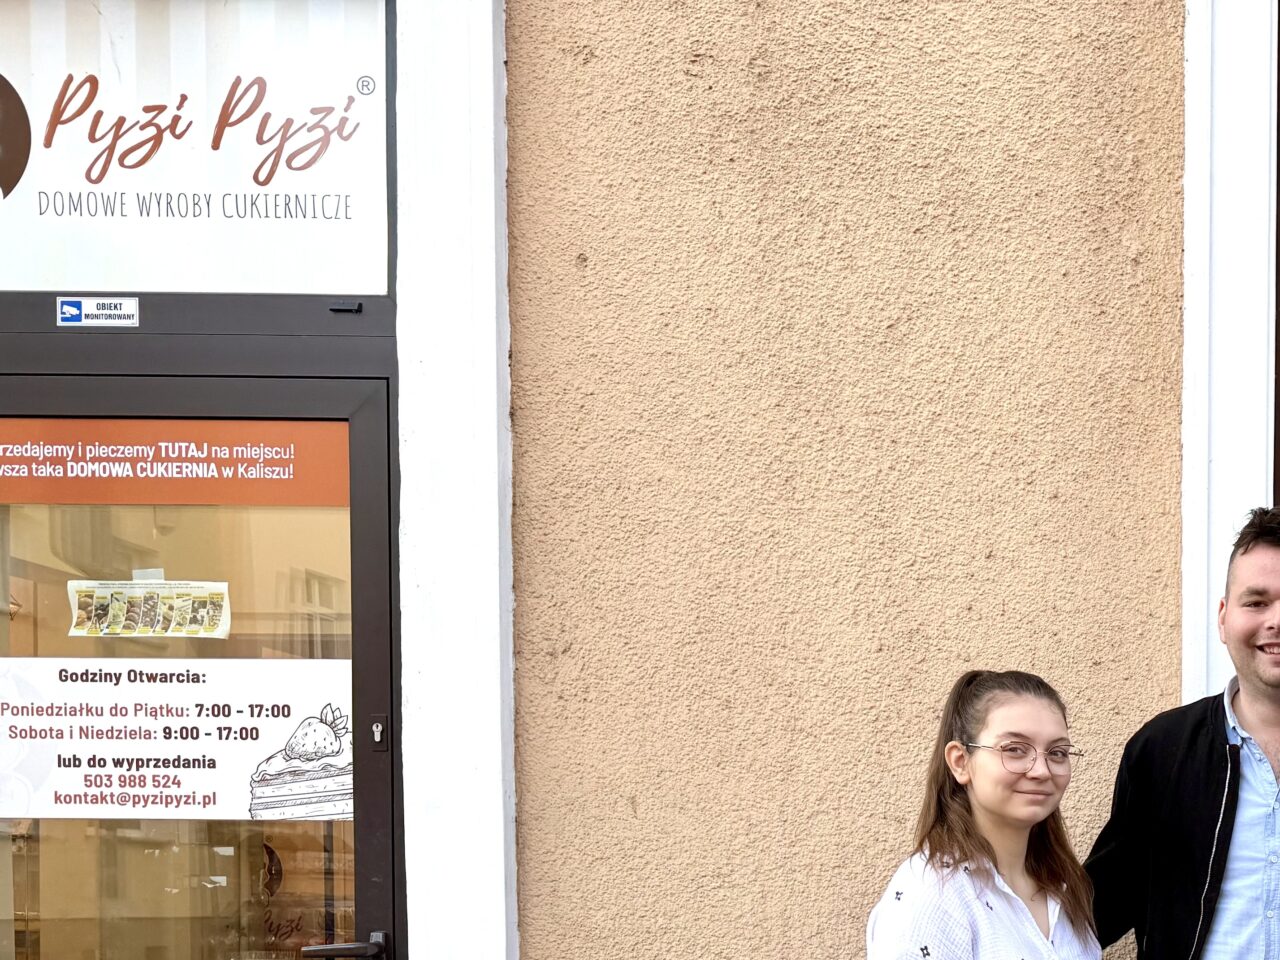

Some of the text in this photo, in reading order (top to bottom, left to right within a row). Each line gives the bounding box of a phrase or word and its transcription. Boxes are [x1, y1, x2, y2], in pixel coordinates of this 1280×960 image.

[43, 73, 360, 186] Pyzi Pyzi
[38, 191, 352, 220] DOMOWE WYROBY CUKIERNICZE
[96, 302, 123, 311] OBIEKT
[84, 313, 135, 321] MONITOROWANY
[0, 441, 295, 462] rzedajemy pieczemy TUTAJ miejscu!
[31, 462, 294, 479] taka DOMOWA CUKIERNIA Kaliszu!
[58, 669, 206, 686] Godziny Otwarcia:
[0, 702, 291, 720] Poniedziałku Piątku: 7:00 17:00
[8, 725, 260, 741] Sobota Niedziela: 9:00 17:00
[112, 754, 216, 772] wyprzedania
[83, 774, 181, 788] 503 988 524
[54, 790, 217, 809] kontakt@pyzipyzi.pl
